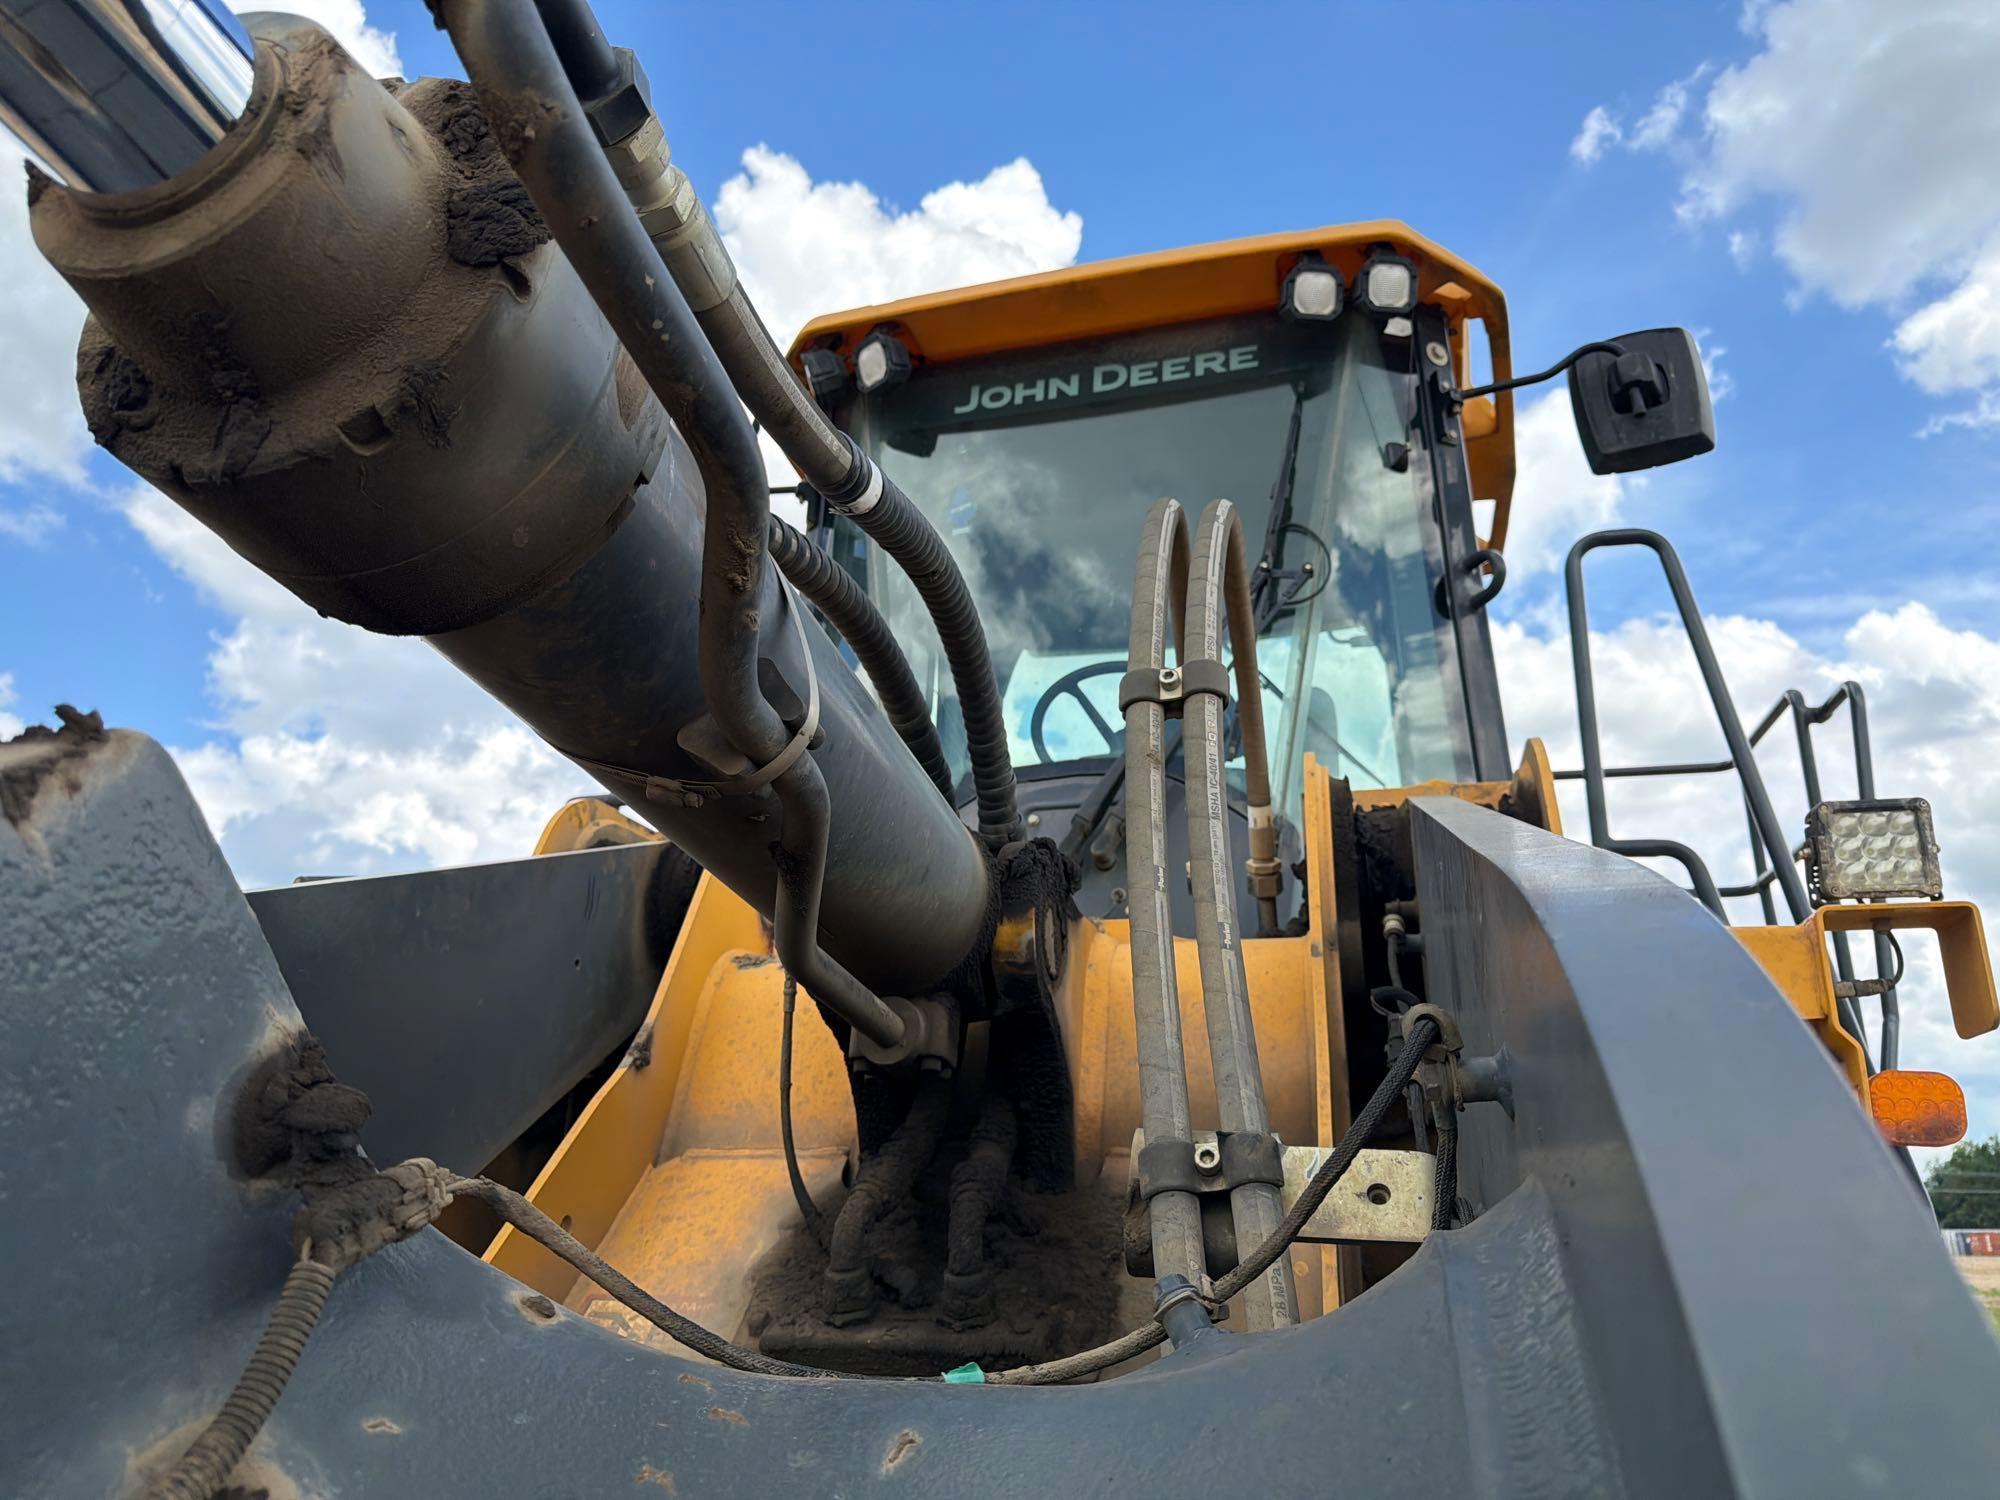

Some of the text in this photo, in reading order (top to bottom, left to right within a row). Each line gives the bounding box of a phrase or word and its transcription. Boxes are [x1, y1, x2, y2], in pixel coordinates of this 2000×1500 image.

[953, 344, 1259, 414] JOHN DEERE
[1207, 753, 1218, 790] IC-40/41
[1208, 792, 1221, 821] MSHA
[1156, 866, 1166, 888] Parker
[1222, 922, 1233, 946] Parker
[1271, 1267, 1287, 1318] 28 MPa
